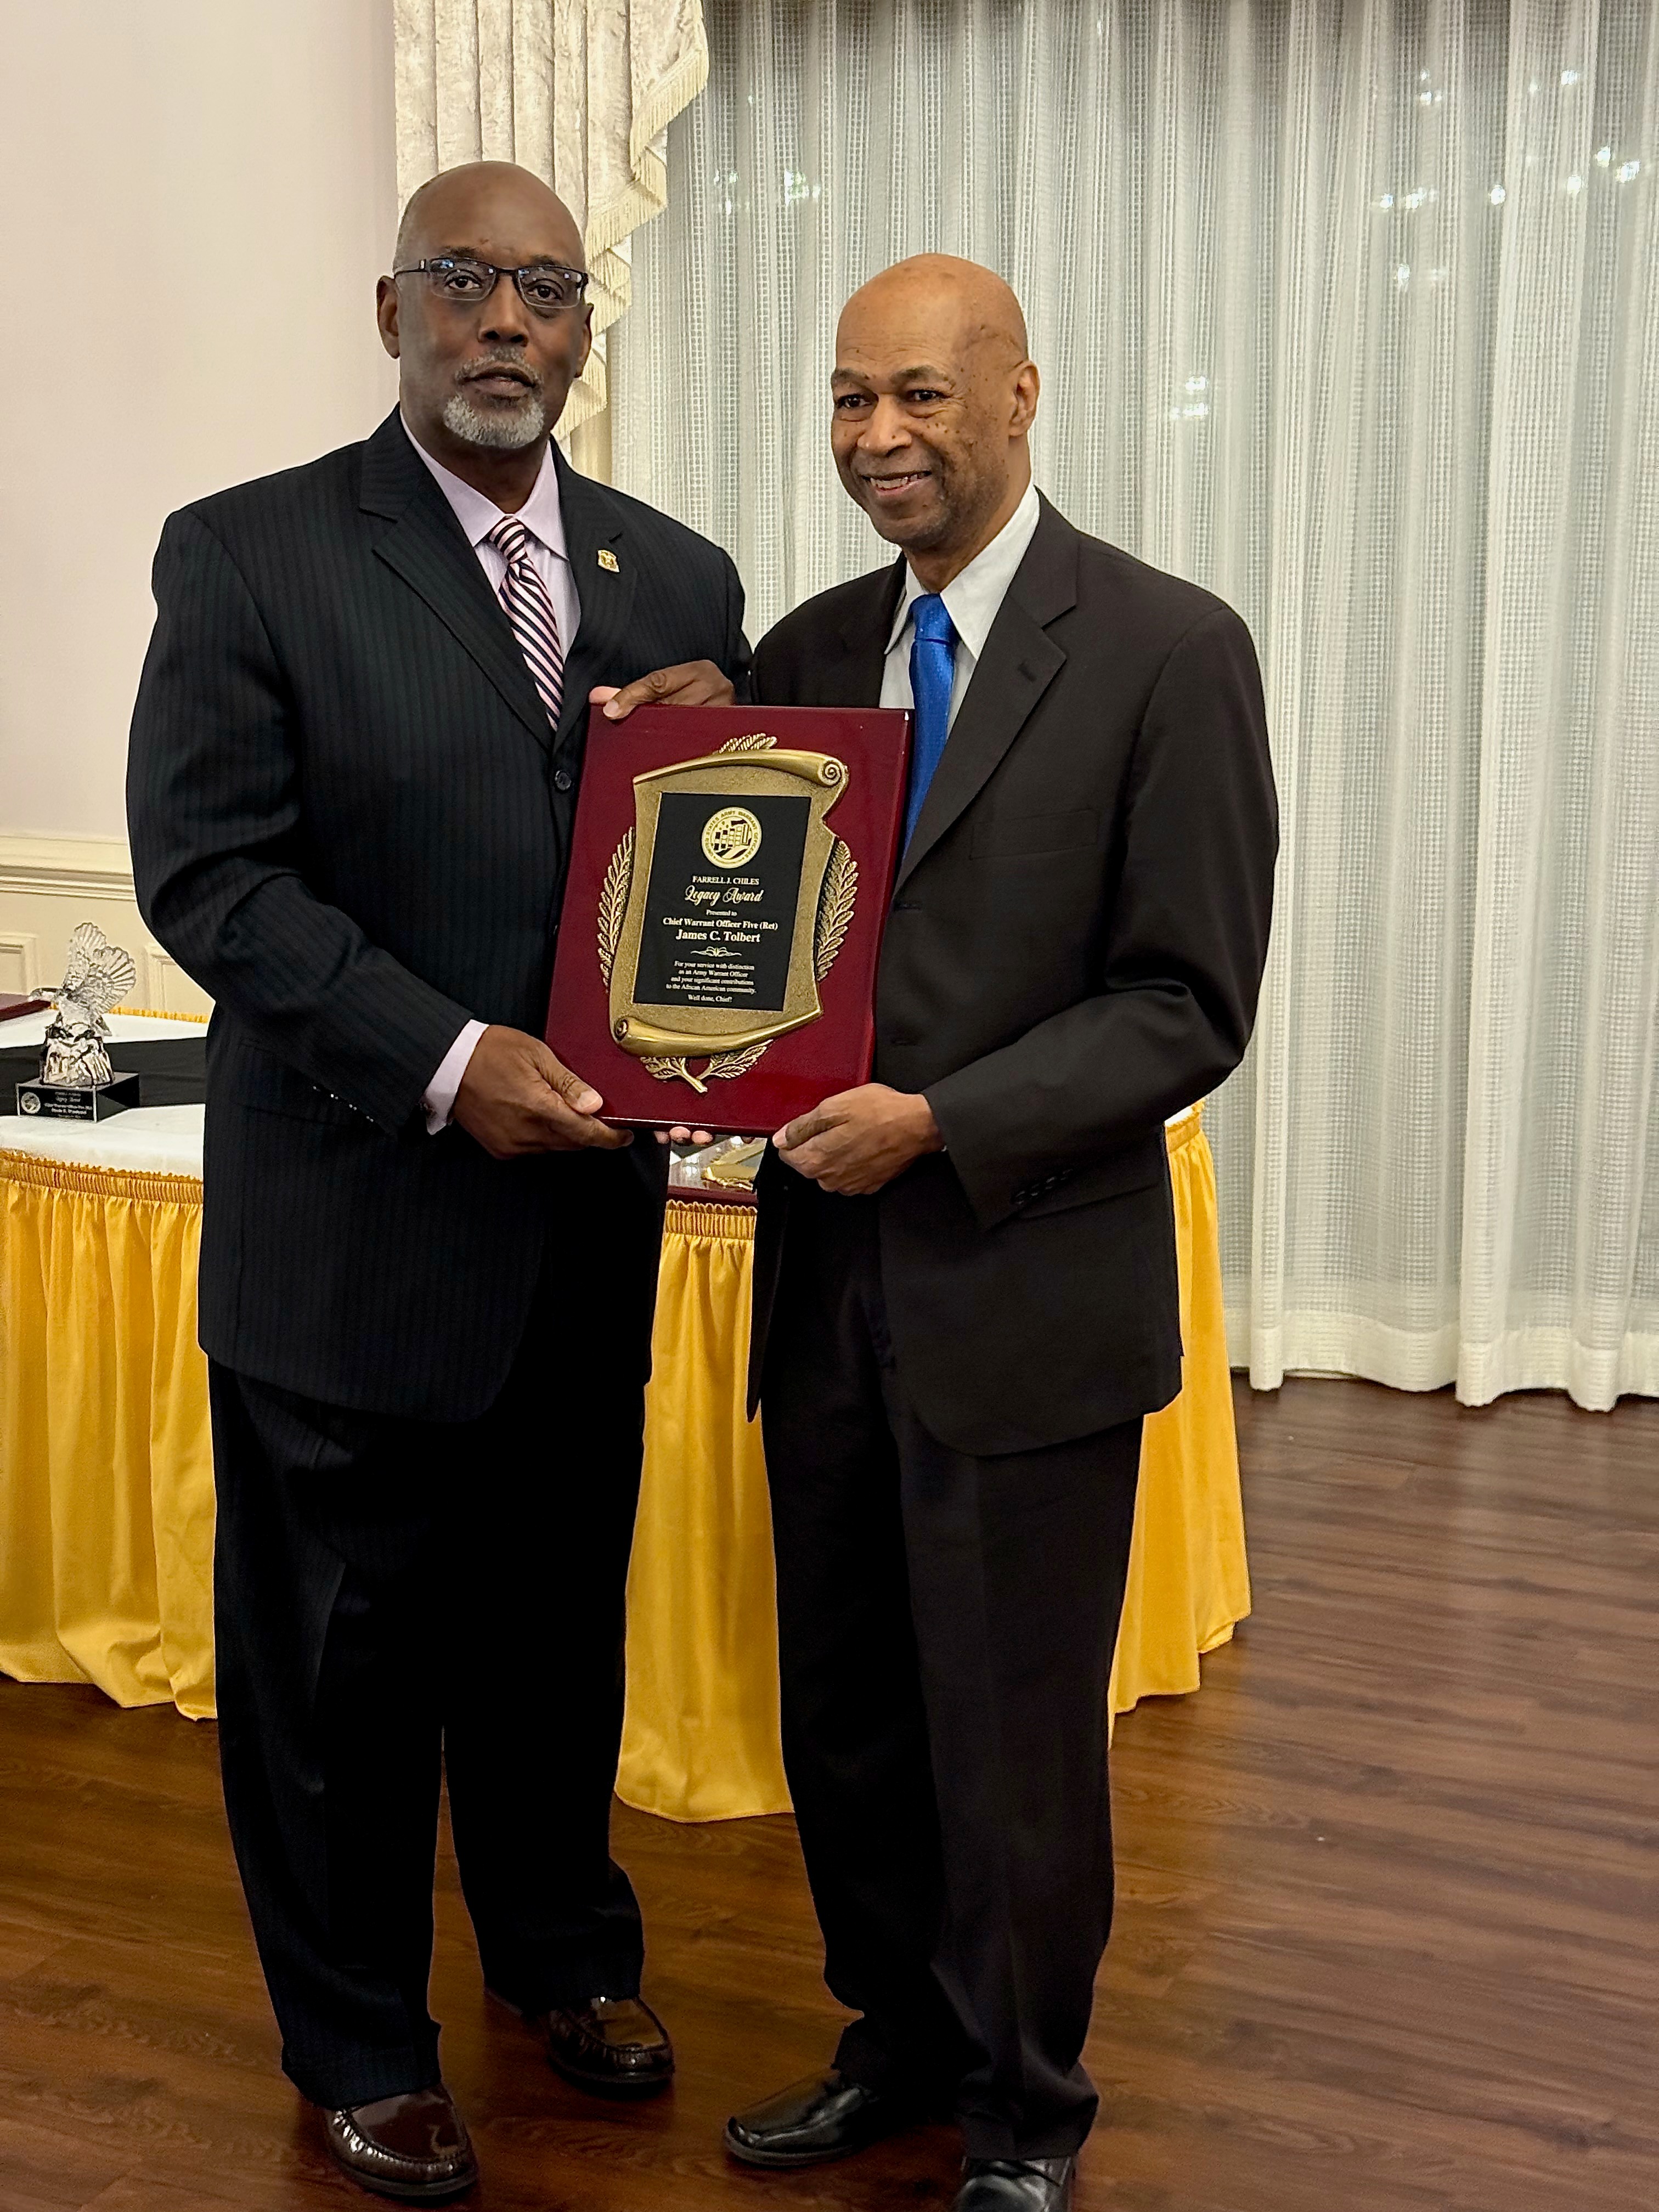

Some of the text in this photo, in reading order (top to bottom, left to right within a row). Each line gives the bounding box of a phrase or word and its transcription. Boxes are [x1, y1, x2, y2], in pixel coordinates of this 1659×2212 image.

[692, 876, 726, 884] FARRELL
[685, 884, 764, 907] Legacy Award
[663, 917, 778, 930] Chief Warrant Officer Five (Ret)
[675, 929, 760, 942] James C. Tolbert
